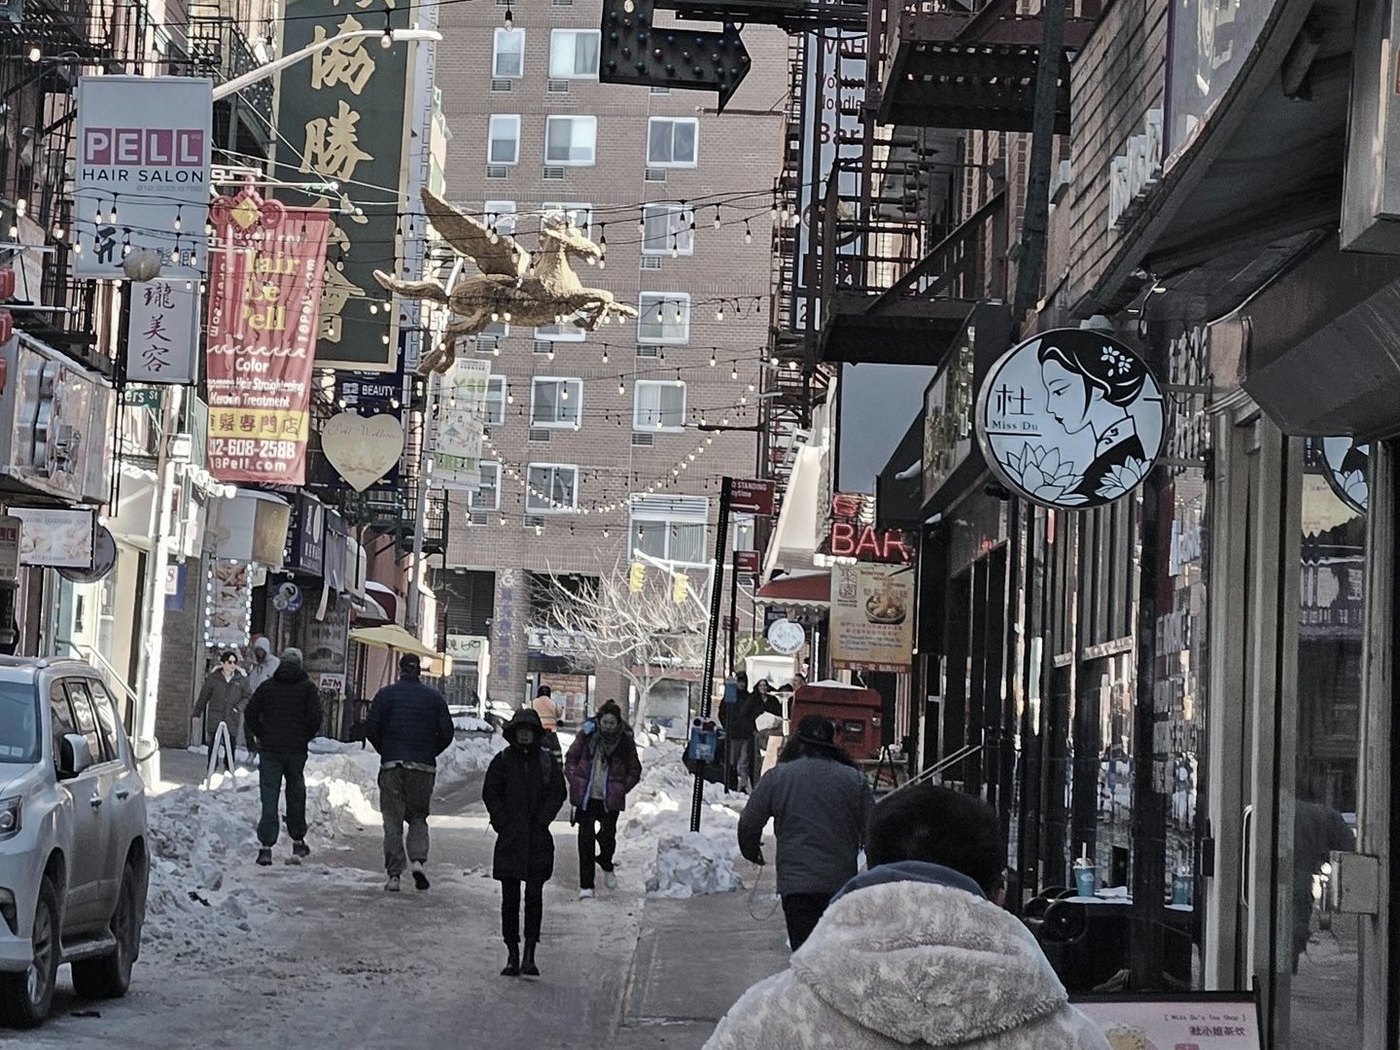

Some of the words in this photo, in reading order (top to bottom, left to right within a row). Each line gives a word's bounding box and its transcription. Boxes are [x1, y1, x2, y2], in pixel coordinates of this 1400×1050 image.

[85, 130, 202, 164] PELL
[82, 169, 129, 182] HAIR
[138, 170, 204, 183] SALON
[235, 357, 270, 372] Color
[362, 385, 394, 396] BEAUTY
[243, 393, 290, 407] Treatment
[995, 384, 1035, 418] 杜
[991, 420, 1017, 430] Miss
[1022, 421, 1039, 431] Du
[208, 439, 297, 459] 12-608-2588
[737, 482, 767, 491] STANDING
[731, 490, 752, 498] nytime
[831, 522, 910, 561] BAR
[322, 678, 342, 689] ATM
